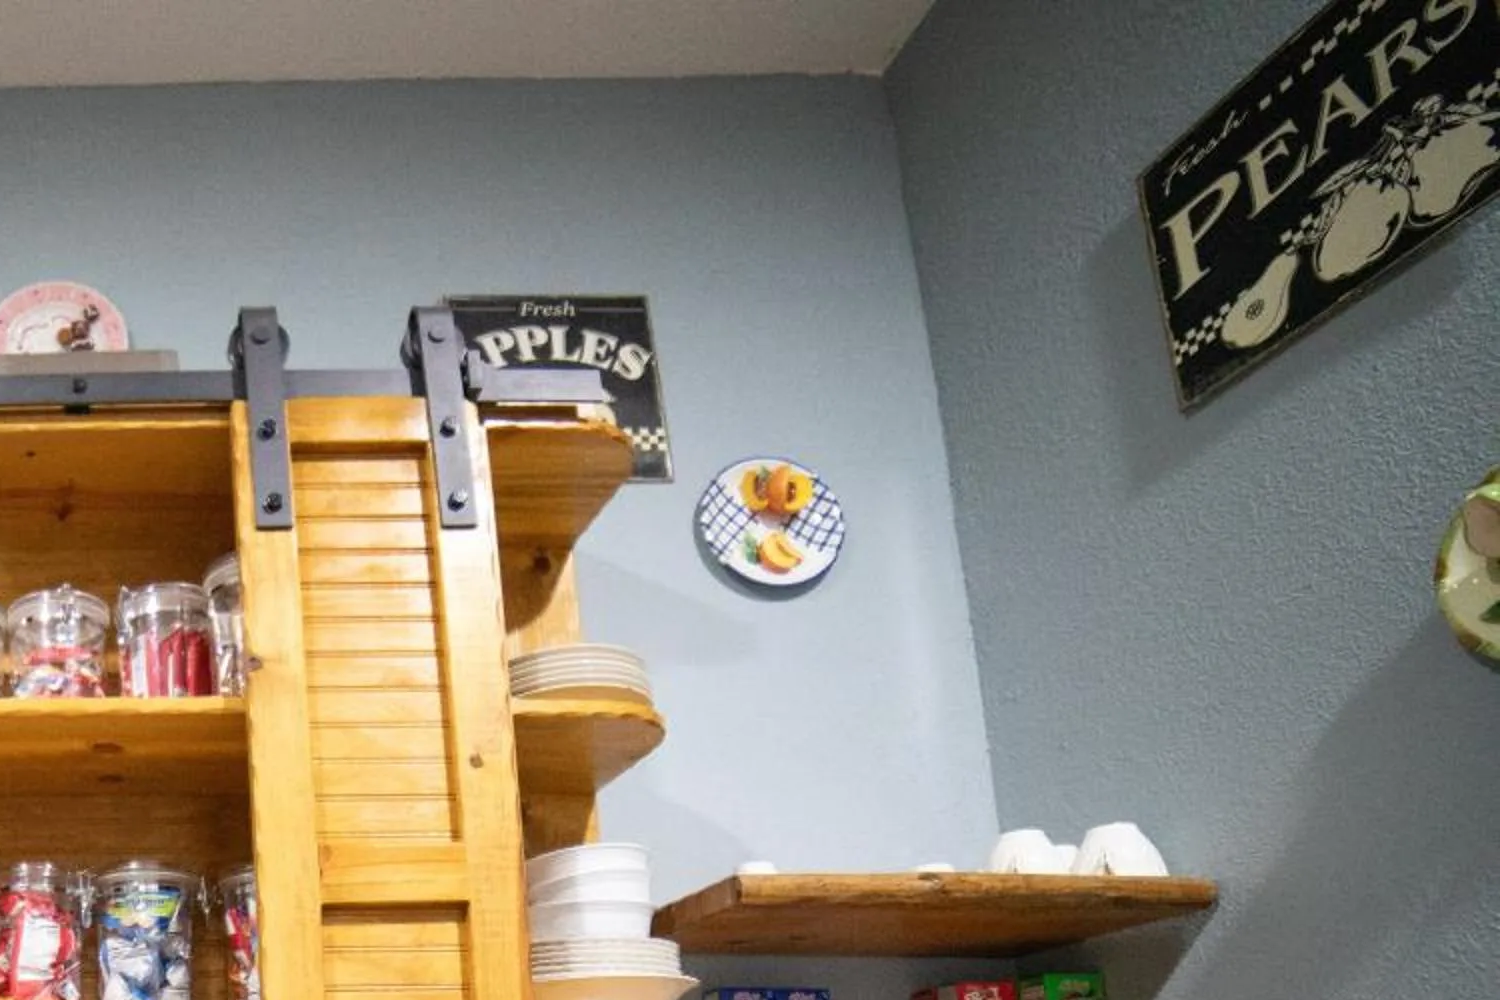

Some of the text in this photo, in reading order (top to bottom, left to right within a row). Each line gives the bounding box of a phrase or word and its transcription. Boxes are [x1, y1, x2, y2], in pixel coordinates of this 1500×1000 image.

[1161, 0, 1478, 301] PEARS
[519, 300, 577, 318] Fresh
[474, 324, 654, 381] PPLES
